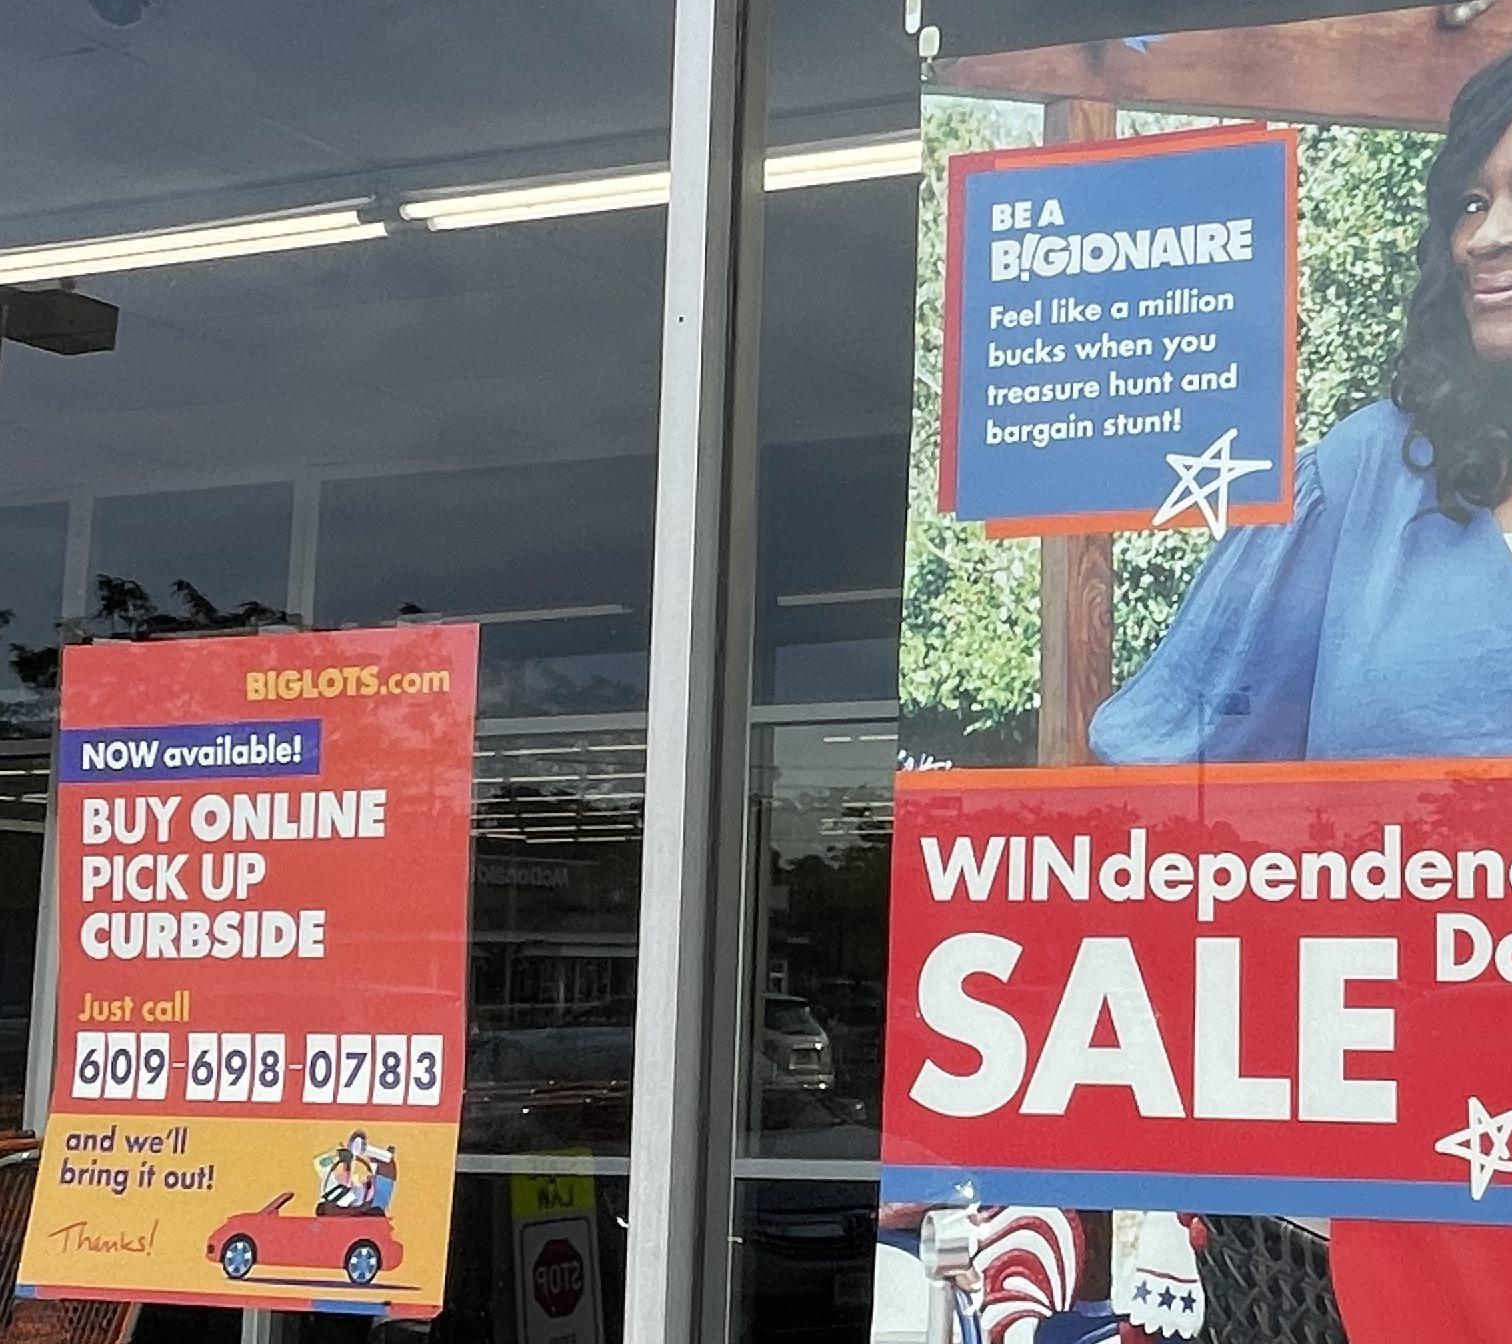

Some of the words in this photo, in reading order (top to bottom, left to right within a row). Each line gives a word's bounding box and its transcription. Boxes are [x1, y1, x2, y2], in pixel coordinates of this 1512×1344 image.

[992, 201, 1031, 231] BE
[1038, 198, 1064, 227] A
[990, 300, 1041, 330] Feel
[1051, 298, 1101, 324] like
[1110, 303, 1128, 320] a
[1139, 289, 1234, 318] million
[988, 337, 1065, 368] bucks
[1075, 333, 1152, 360] when
[1162, 334, 1217, 361] you
[987, 376, 1100, 406] treasure
[1109, 371, 1173, 397] hunt
[1180, 363, 1238, 390] and
[986, 413, 1093, 448] bargain
[1103, 407, 1182, 437] stunt!
[246, 667, 450, 701] BIGLOTS.com
[82, 741, 158, 770] NOW
[163, 735, 301, 768] available!
[82, 794, 181, 844] BUY
[191, 789, 386, 841] ONLINE
[82, 854, 188, 901] PICK
[200, 853, 266, 900] UP
[81, 909, 325, 958] CURBSIDE
[78, 994, 135, 1022] Just
[141, 991, 190, 1022] call
[909, 932, 1398, 1124] SALE
[65, 1126, 116, 1154] and
[124, 1126, 187, 1154] we'll
[60, 1160, 128, 1193] bring
[138, 1160, 156, 1187] it
[163, 1163, 215, 1190] out!
[48, 1218, 160, 1257] Thanks!
